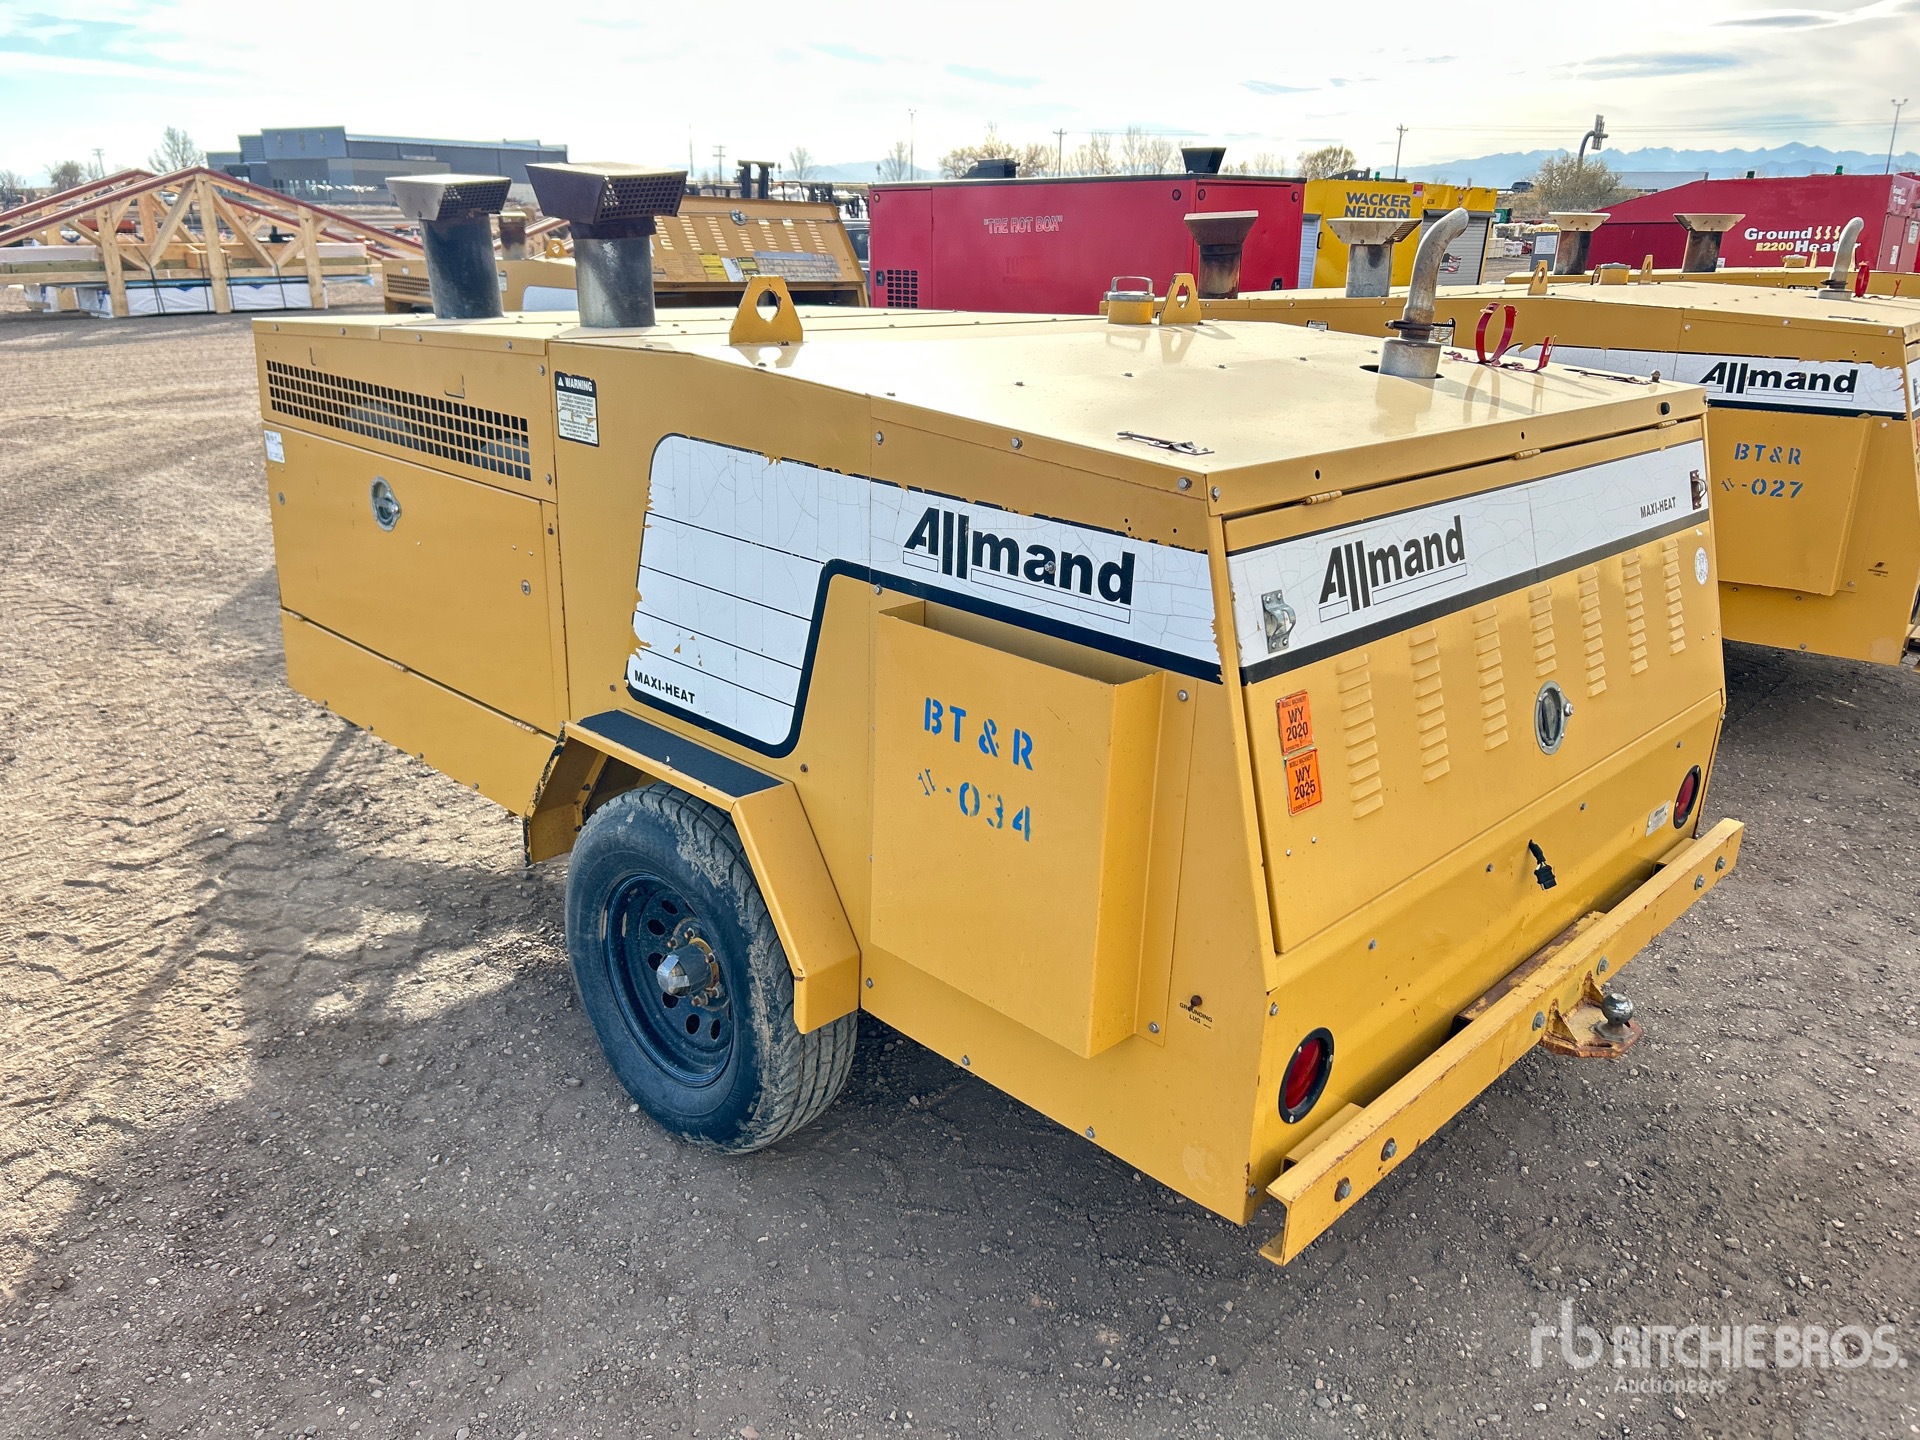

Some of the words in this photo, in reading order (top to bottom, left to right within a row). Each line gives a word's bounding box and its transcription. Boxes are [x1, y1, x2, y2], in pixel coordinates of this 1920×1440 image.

[1346, 192, 1411, 207] WACKER
[1345, 205, 1411, 219] NEUSON
[983, 217, 1009, 235] "THE
[1010, 216, 1033, 234] HOT
[1744, 226, 1813, 240] Ground
[1756, 242, 1794, 252] E2200
[565, 377, 593, 392] WARNING
[1699, 361, 1859, 394] Allmand
[1640, 497, 1676, 518] MAXI-HEAT
[904, 506, 1136, 605] Allmand
[1318, 514, 1466, 611] Allmand
[634, 669, 696, 704] MAXI-HEAT
[1288, 706, 1304, 724] WY
[1286, 721, 1309, 741] 2020
[1295, 764, 1311, 783] WY
[1293, 780, 1316, 801] 2025
